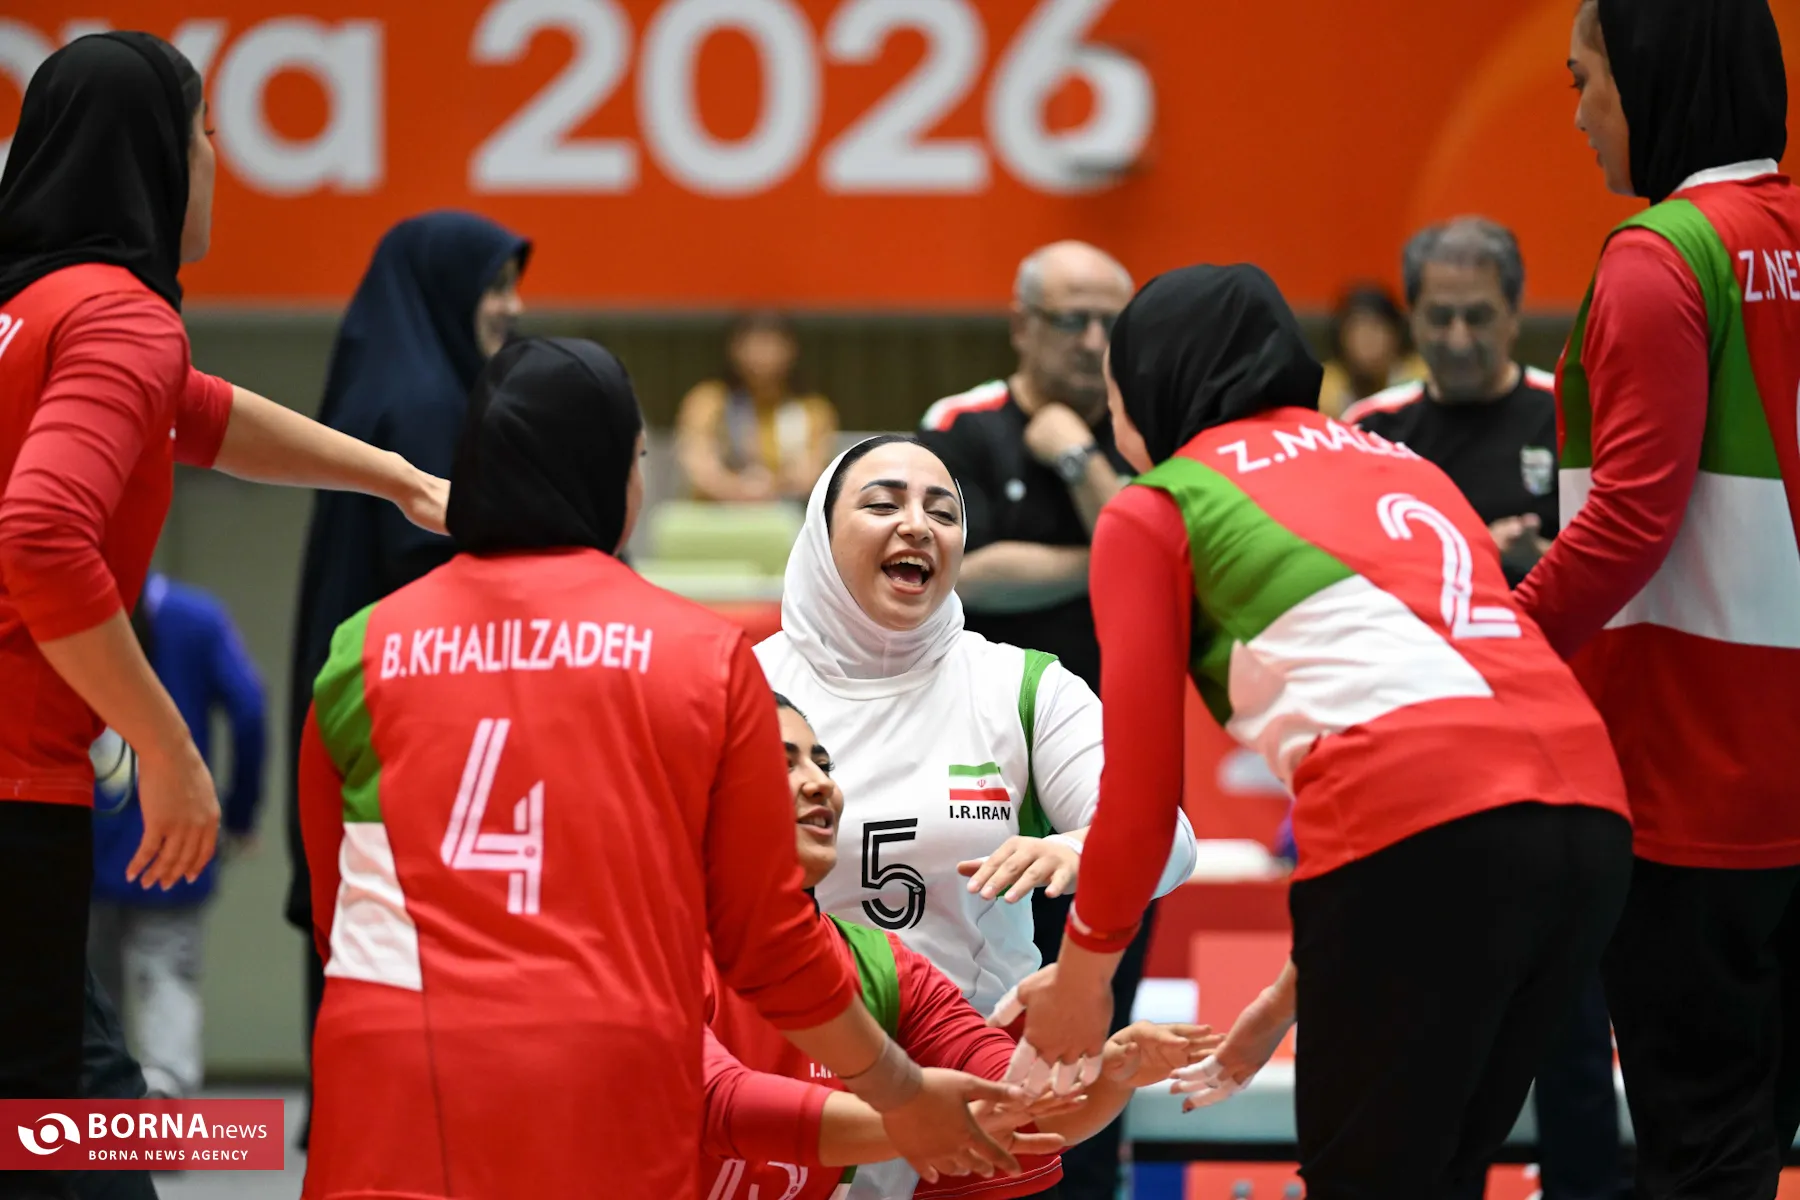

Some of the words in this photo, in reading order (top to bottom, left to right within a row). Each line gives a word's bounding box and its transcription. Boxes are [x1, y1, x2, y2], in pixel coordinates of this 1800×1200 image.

[468, 0, 1154, 196] 2026
[1738, 248, 1800, 302] Z.NE
[1376, 492, 1522, 640] 2
[380, 618, 653, 680] B.KHALILZADEH
[440, 718, 545, 915] 4
[949, 805, 1011, 821] I.R.IRAN
[861, 818, 926, 930] 5
